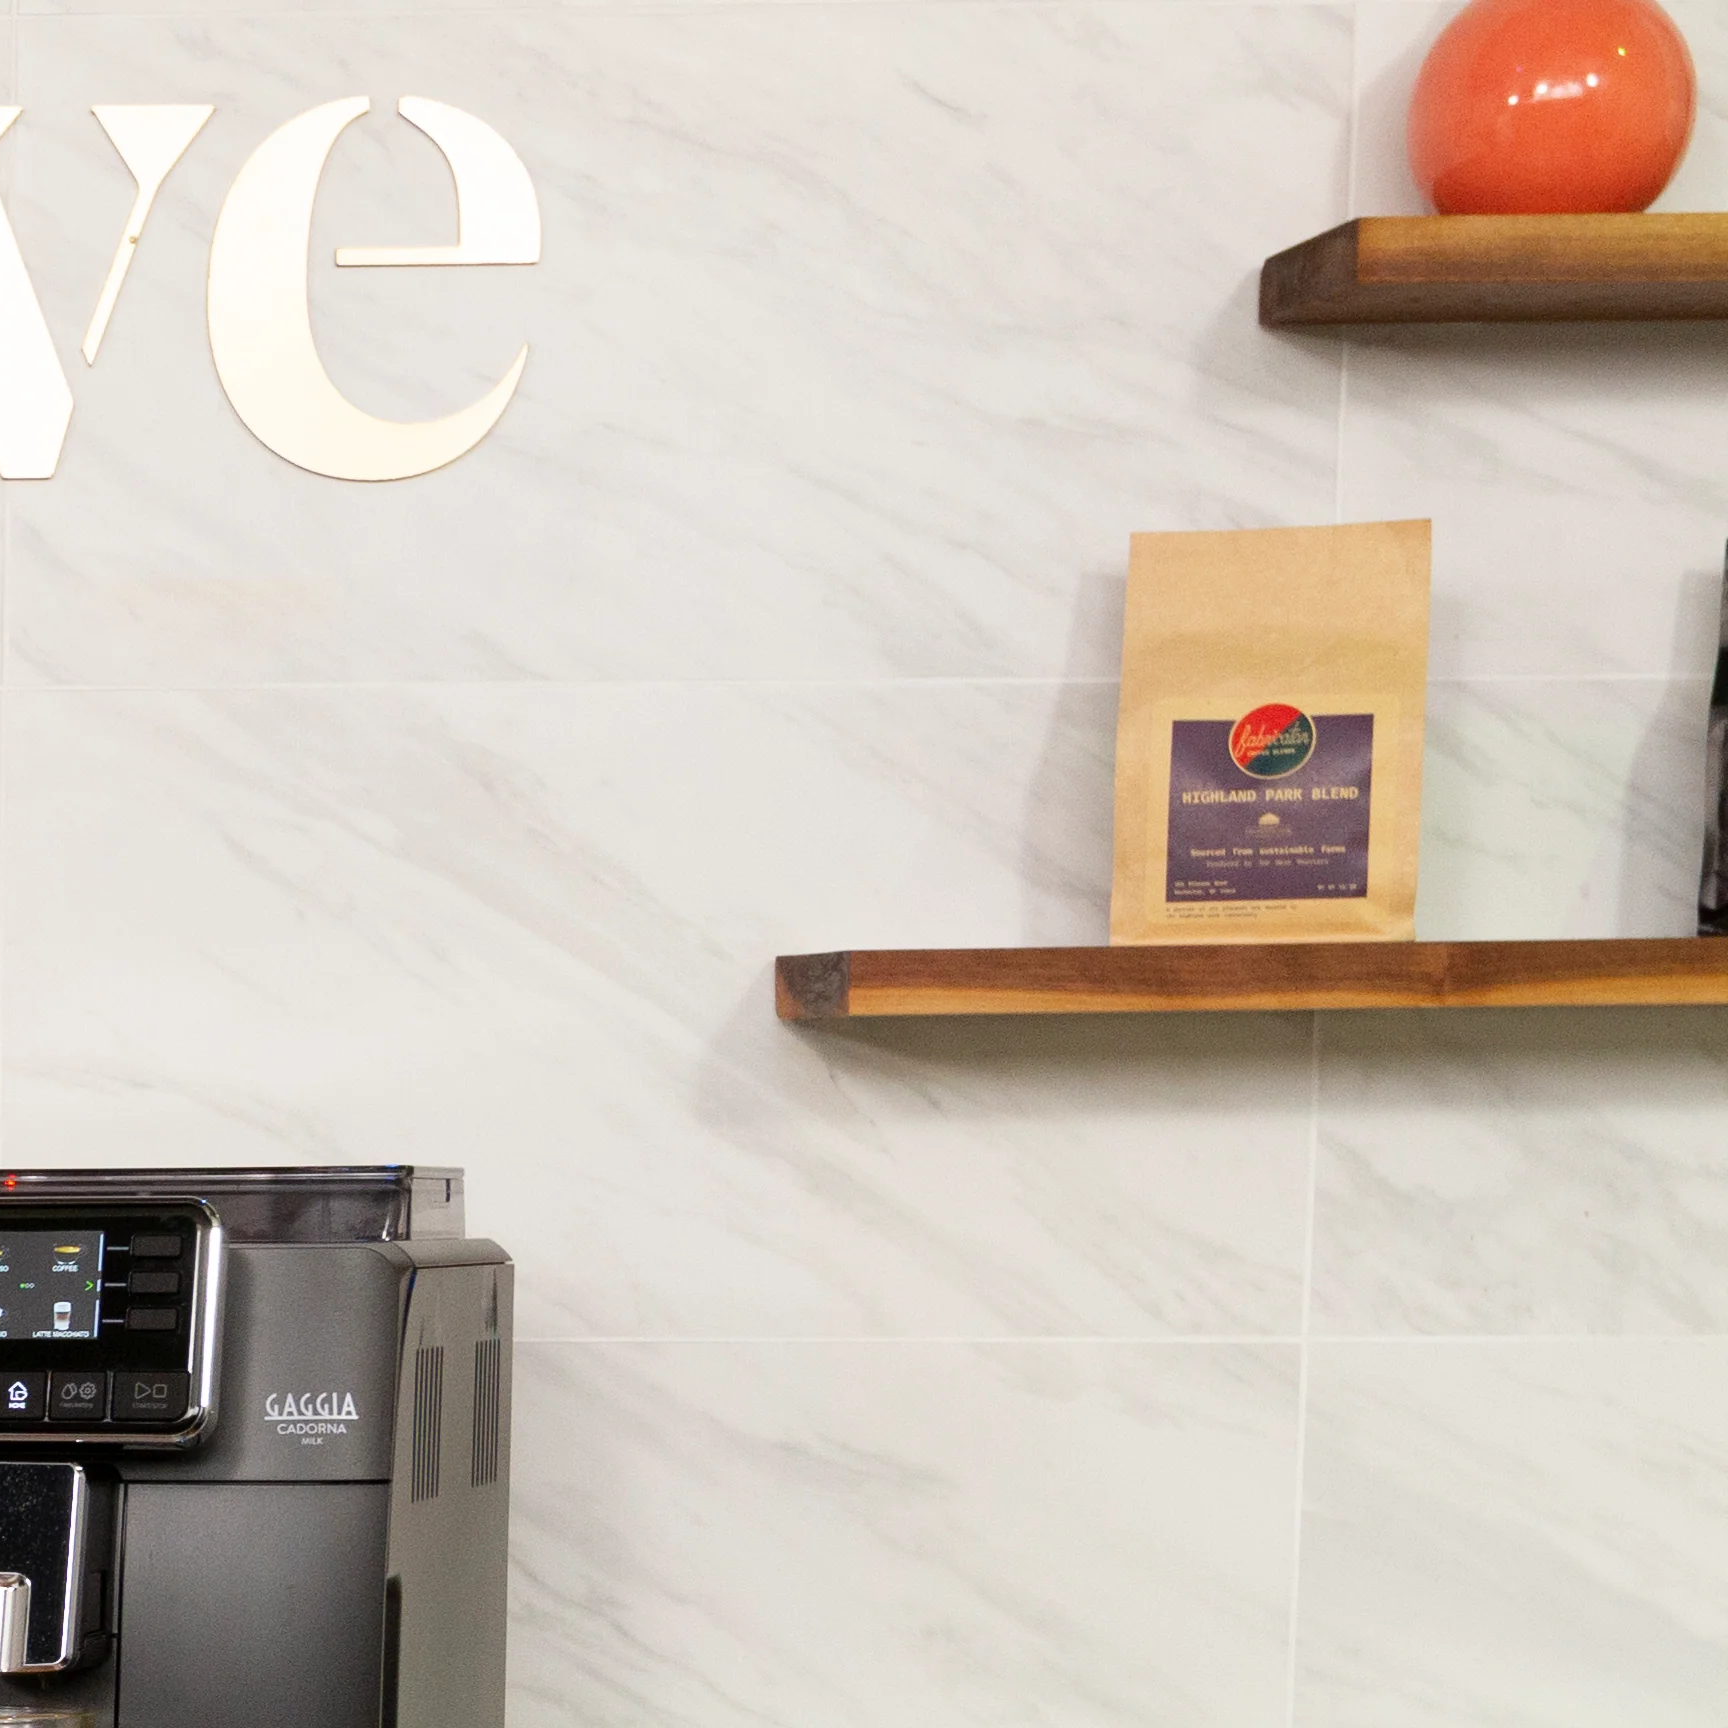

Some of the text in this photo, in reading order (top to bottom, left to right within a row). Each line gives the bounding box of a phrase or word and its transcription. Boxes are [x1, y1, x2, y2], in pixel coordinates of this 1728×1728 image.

[1181, 786, 1360, 804] HIGHLAND PARK BLEND
[52, 1264, 79, 1272] COFFEE
[32, 1330, 52, 1338] LATTE
[265, 1392, 359, 1418] GAGGIA
[276, 1423, 347, 1435] CADORNA
[301, 1437, 324, 1445] MILK
